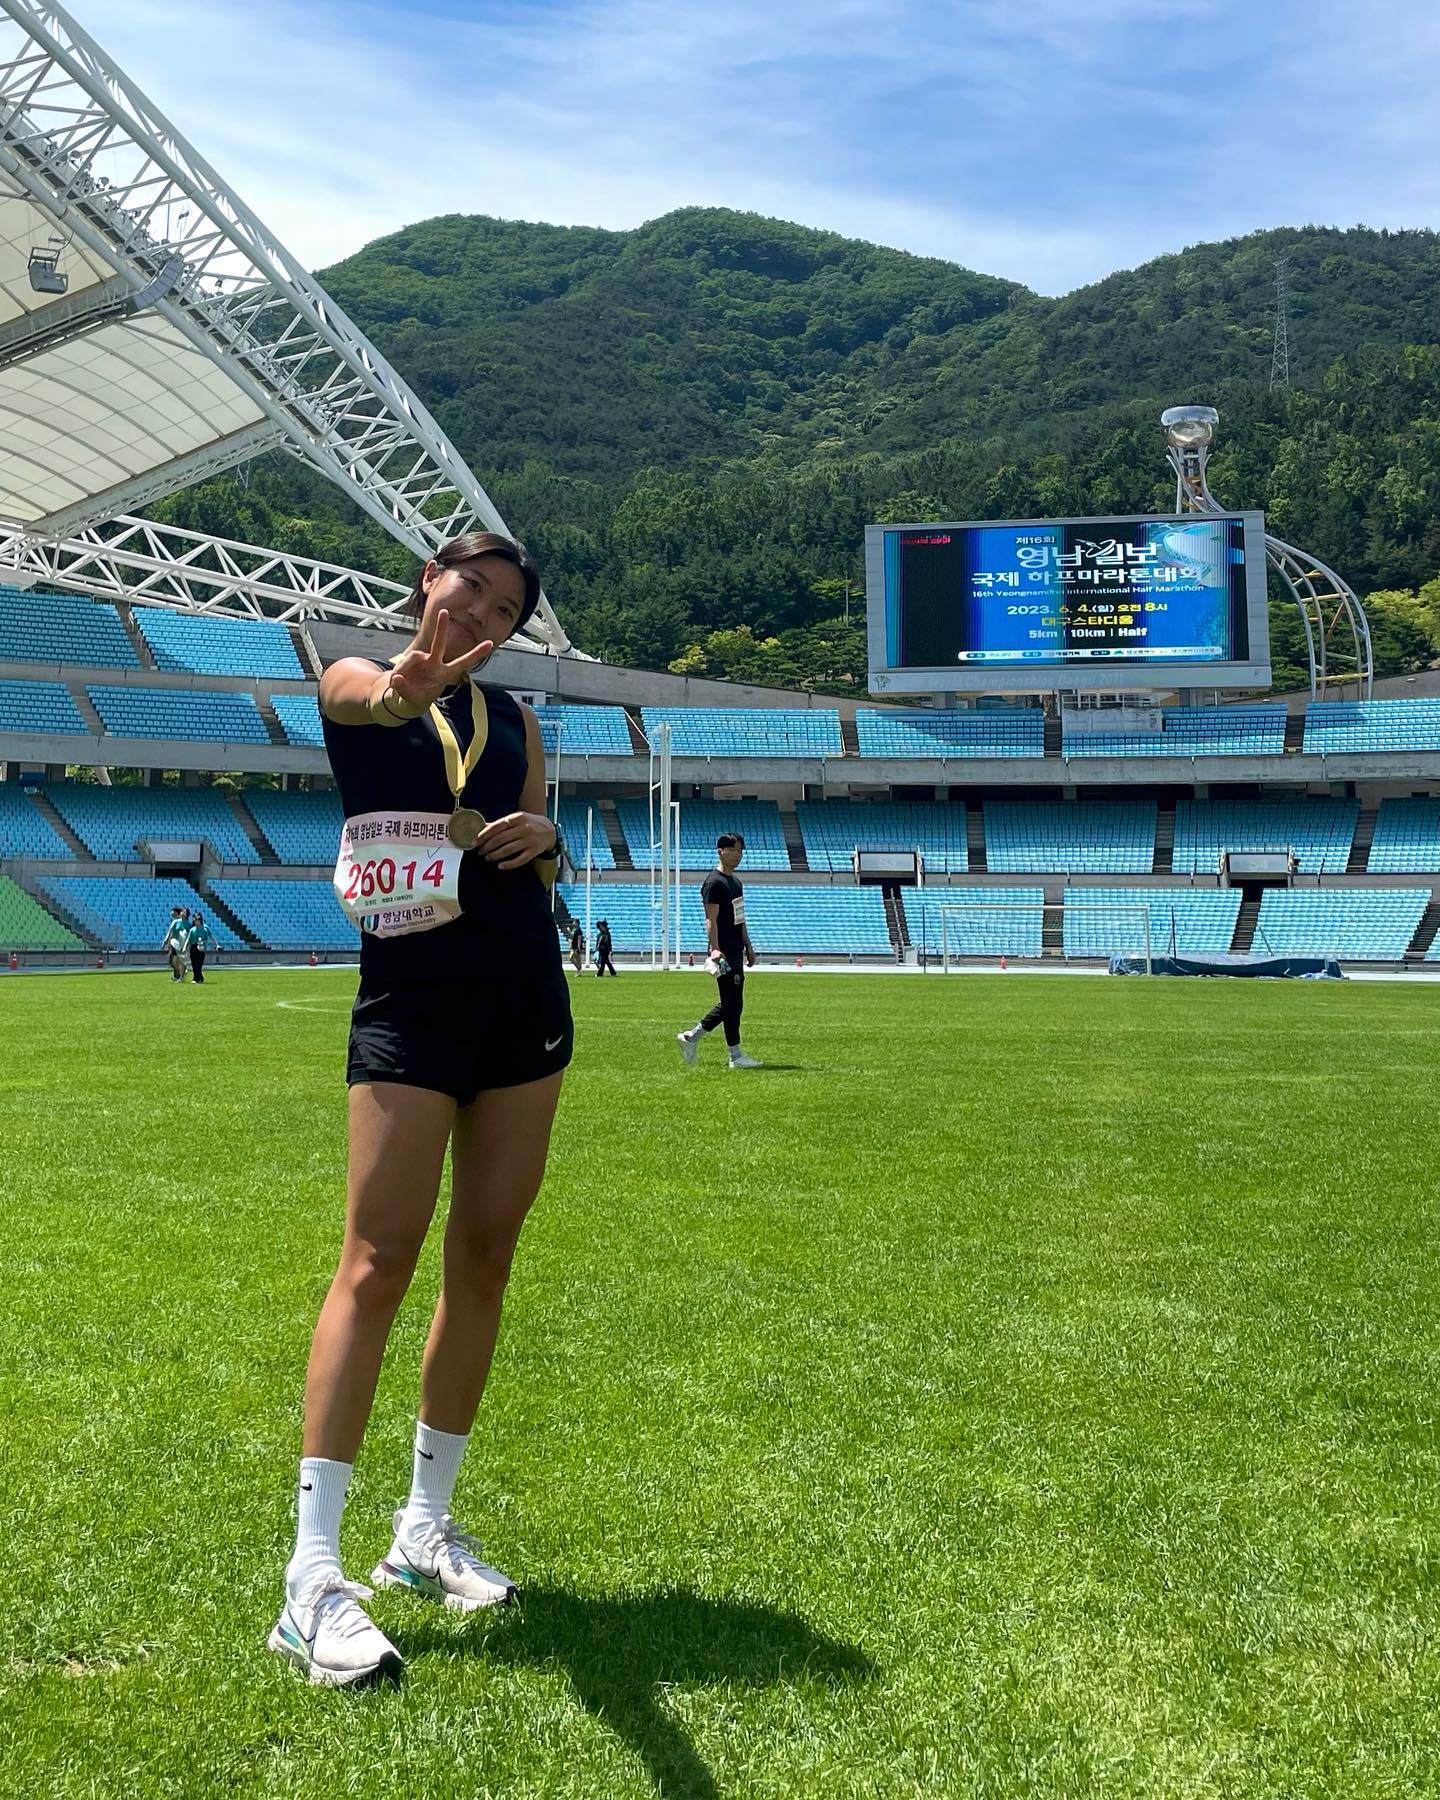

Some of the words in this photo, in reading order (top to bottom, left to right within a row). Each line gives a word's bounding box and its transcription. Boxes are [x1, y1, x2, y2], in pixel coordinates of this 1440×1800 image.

[1015, 535, 1055, 545] 제16회
[1016, 540, 1160, 569] 영남일보
[971, 571, 1020, 587] 국제
[1027, 566, 1202, 586] 하프마라톤대회
[972, 590, 994, 598] 16th
[1132, 585, 1153, 593] Half
[1155, 584, 1205, 593] Marathon
[1007, 605, 1055, 615] 2023.
[1117, 603, 1142, 612] 오전
[1144, 602, 1168, 612] 8시
[1028, 629, 1058, 638] 5km
[1070, 628, 1107, 638] 10km
[1117, 627, 1148, 637] Half
[360, 820, 384, 841] 영남일보
[385, 820, 401, 838] 국제
[343, 858, 444, 899] 26014
[382, 905, 434, 923] 영남대학교
